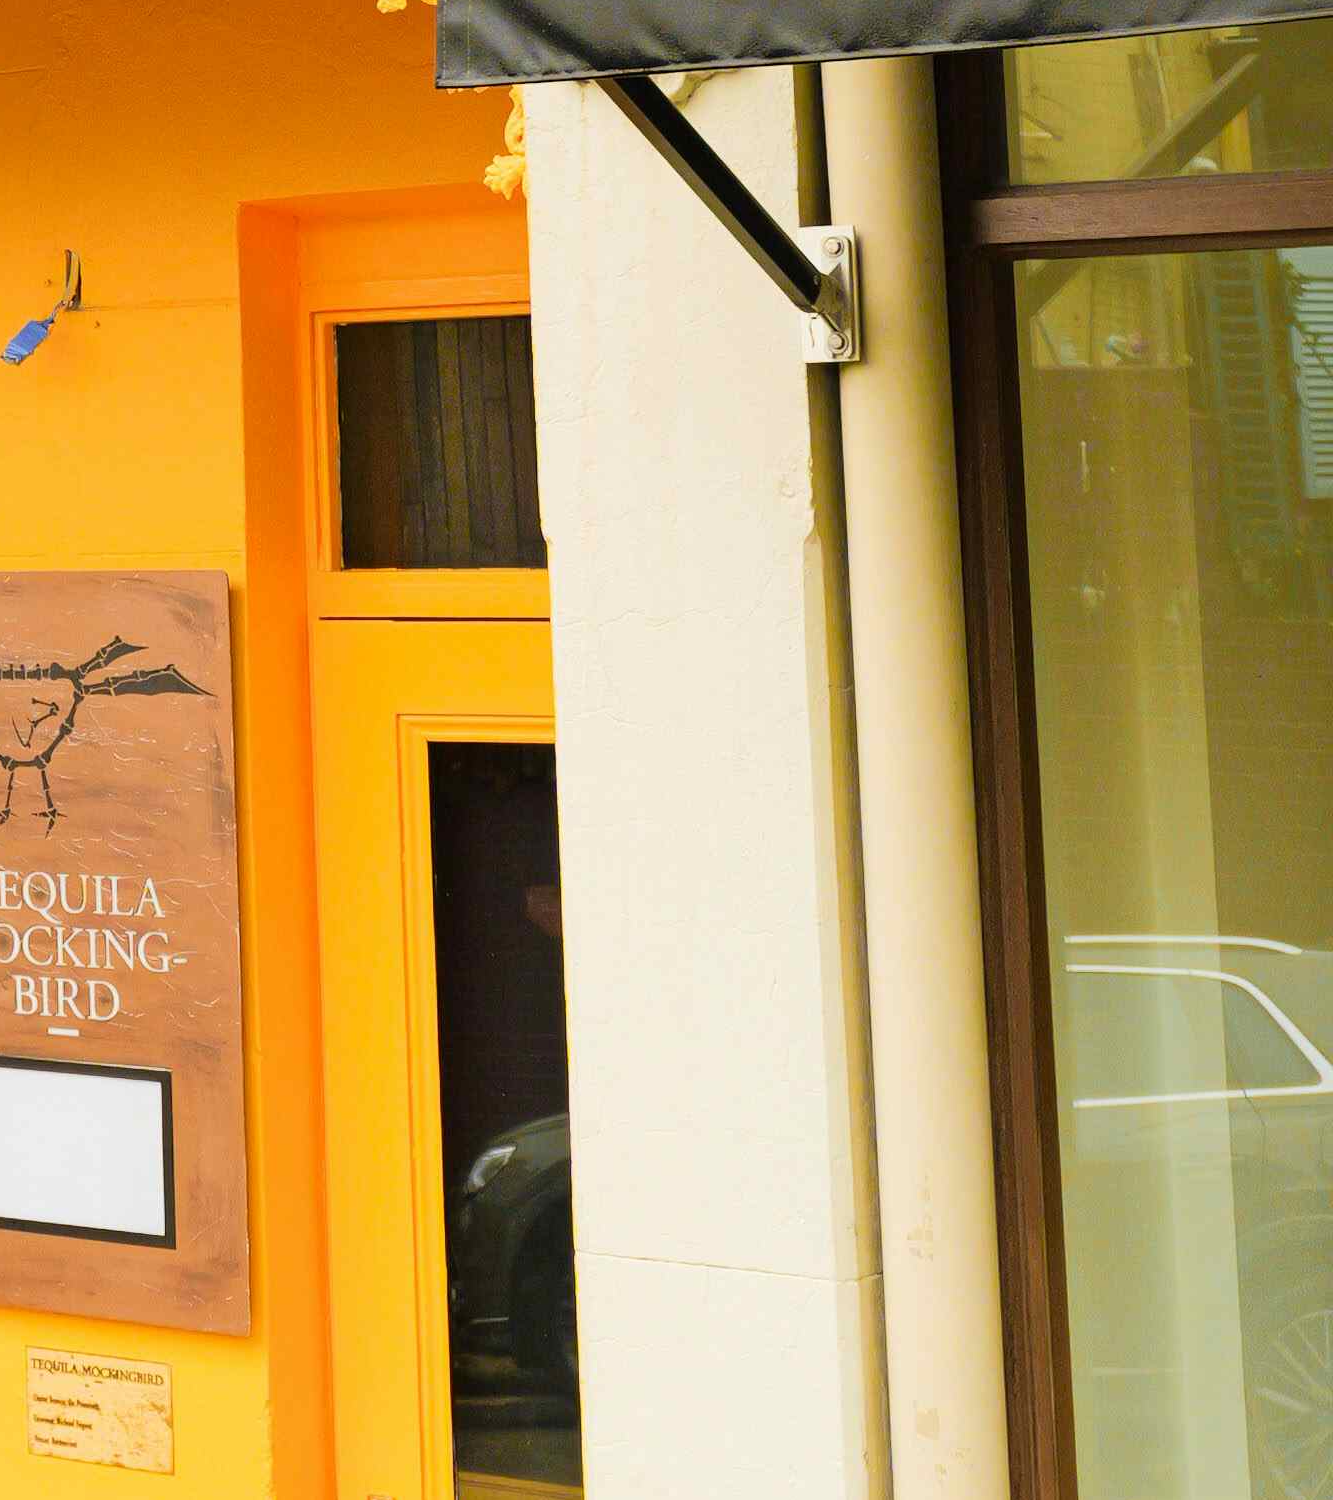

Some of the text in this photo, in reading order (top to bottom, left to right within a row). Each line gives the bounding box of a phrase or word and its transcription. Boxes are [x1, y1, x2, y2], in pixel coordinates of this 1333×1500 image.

[12, 974, 121, 1022] BIRD
[31, 1358, 165, 1386] TEQUILA MOCKINGBIRD
